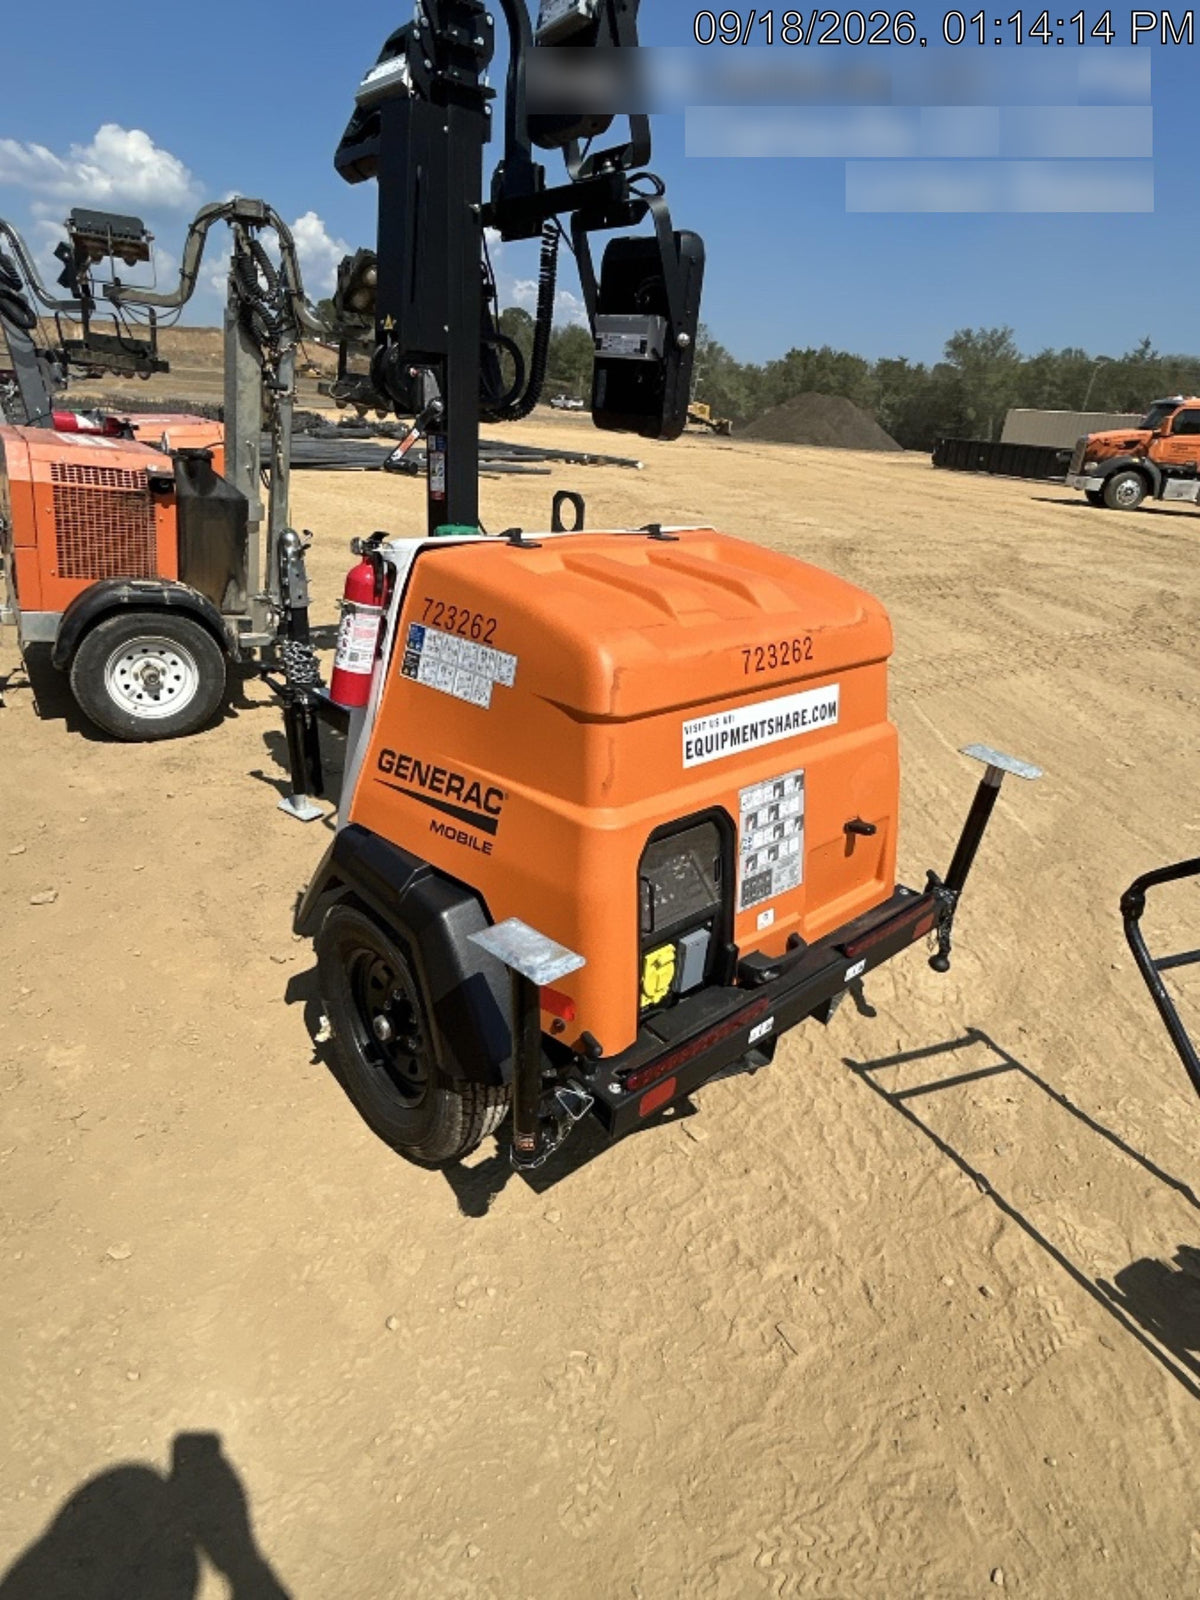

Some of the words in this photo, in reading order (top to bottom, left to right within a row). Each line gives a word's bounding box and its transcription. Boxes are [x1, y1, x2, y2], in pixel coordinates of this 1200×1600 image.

[422, 597, 498, 644] 723262
[741, 636, 814, 675] 723262
[684, 721, 707, 735] VISIT
[685, 701, 837, 760] EQUIPMENTSHARE.COM
[377, 748, 504, 815] GENERAC
[429, 819, 493, 855] MOBILE
